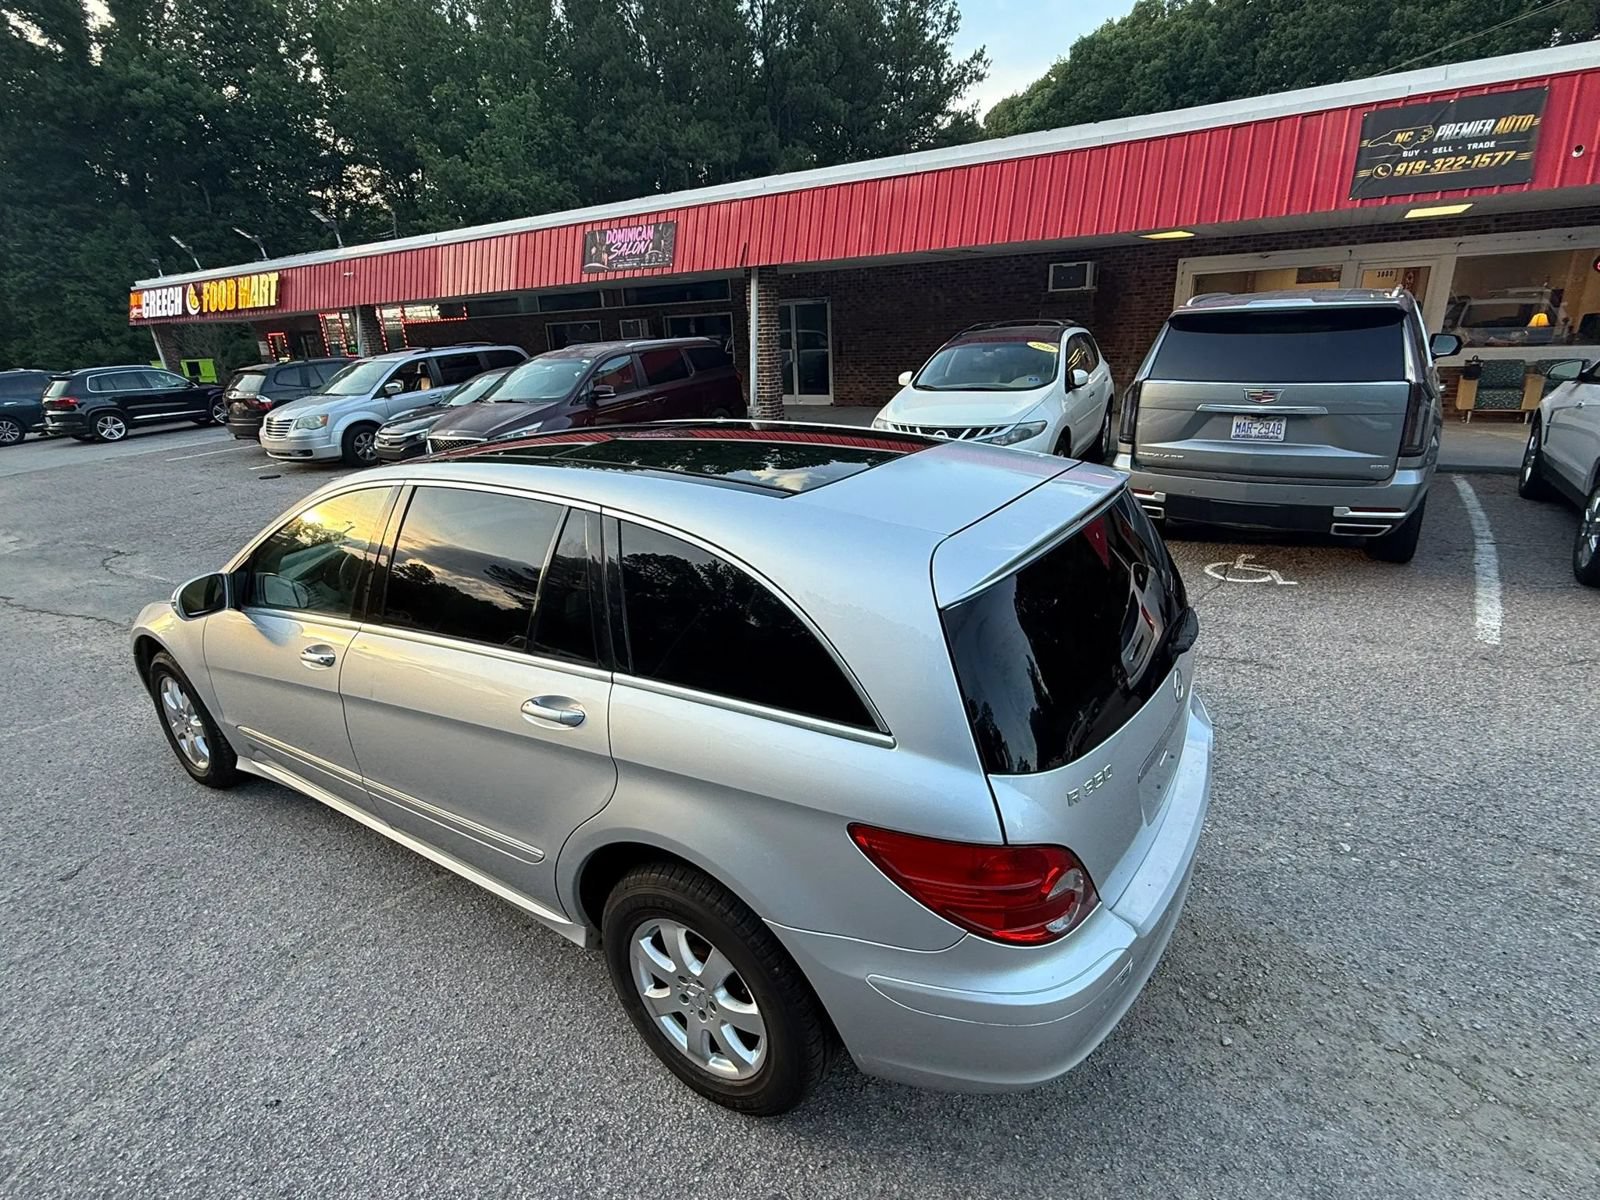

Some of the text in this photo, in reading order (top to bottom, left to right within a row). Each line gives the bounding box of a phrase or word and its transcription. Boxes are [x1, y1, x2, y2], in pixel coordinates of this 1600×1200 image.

[1394, 113, 1535, 144] NC PREMIER AUTO
[1402, 149, 1420, 158] BUY
[1432, 146, 1454, 155] SELL
[1467, 141, 1496, 151] TRADE
[1393, 150, 1517, 177] 919-322-1577
[606, 225, 654, 245] DOMINICAN
[608, 240, 650, 260] SALON
[202, 278, 237, 313] FOOD
[237, 272, 280, 310] MART
[1067, 788, 1080, 807] R
